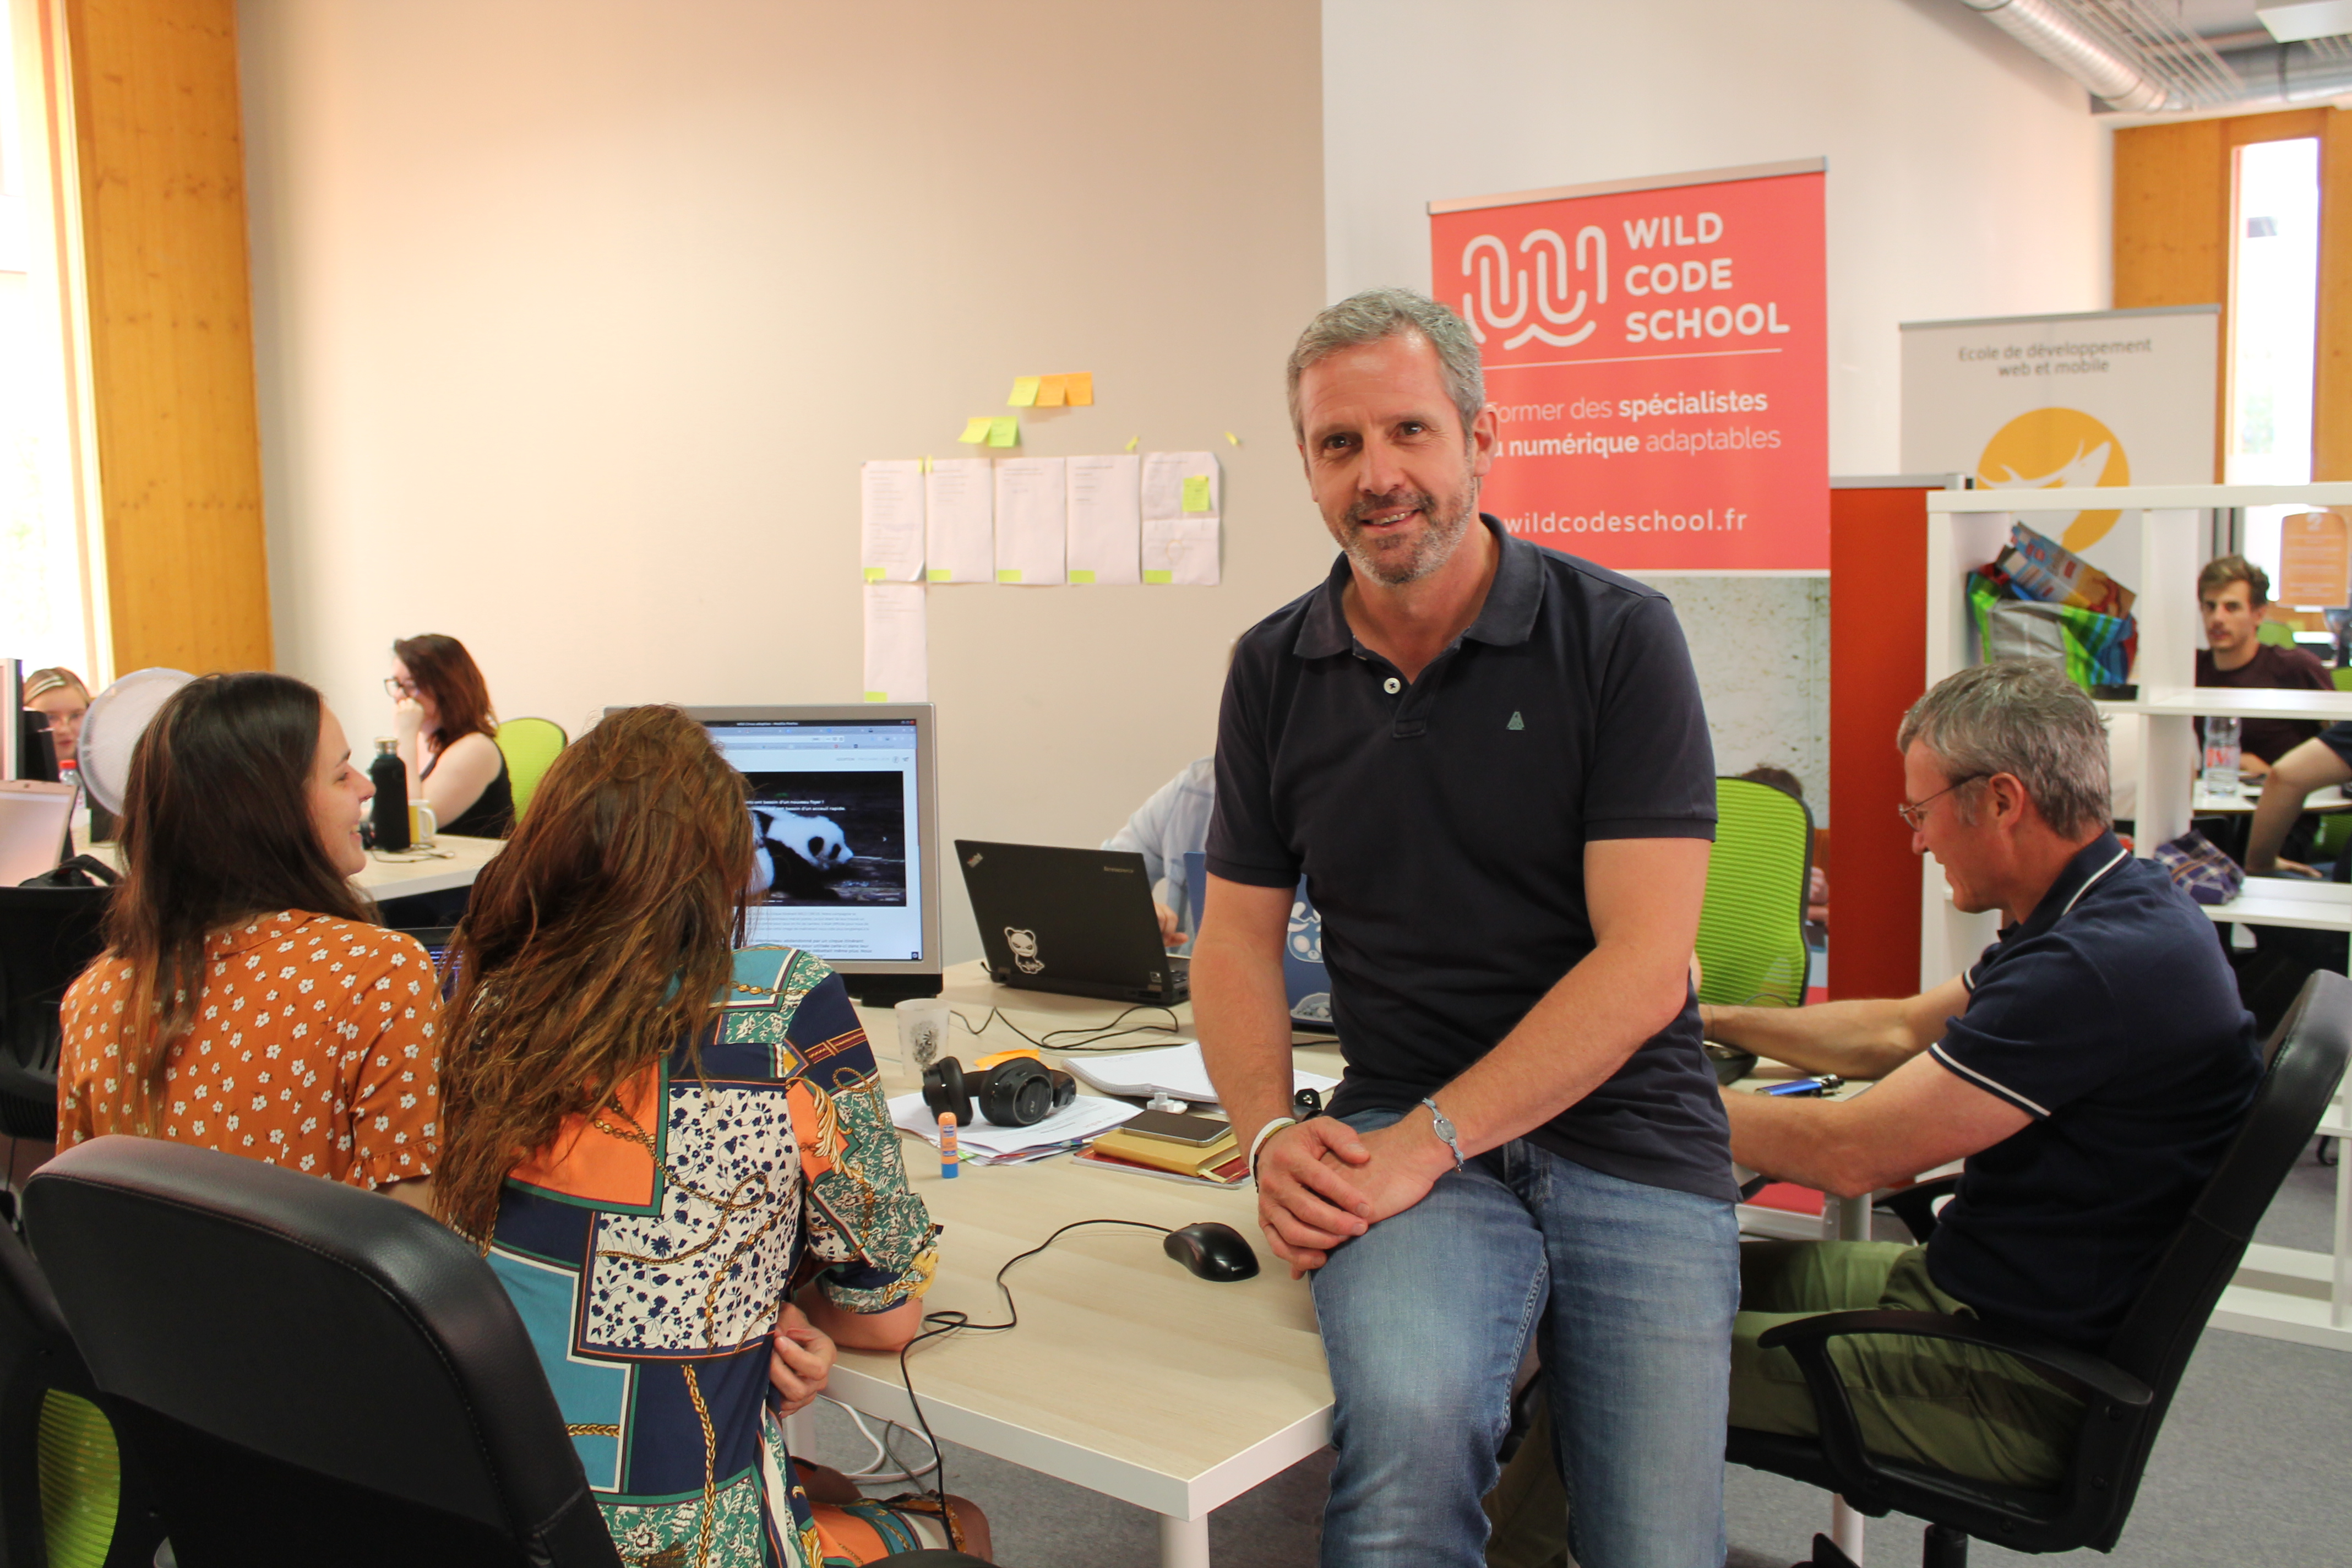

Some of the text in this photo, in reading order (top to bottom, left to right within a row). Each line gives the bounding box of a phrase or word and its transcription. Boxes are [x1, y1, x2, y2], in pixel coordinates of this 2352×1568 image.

[1623, 211, 1724, 250] WILD
[1625, 257, 1733, 297] CODE
[1625, 302, 1790, 343] SCHOOL
[1958, 338, 2152, 361] Ecole de développement
[1998, 360, 2110, 377] web et mobile
[1569, 396, 1613, 420] des
[1618, 390, 1768, 422] spécialistes
[1509, 432, 1640, 459] numérique
[1645, 426, 1782, 456] adaptables
[1503, 508, 1747, 533] wildcodeschool.fr
